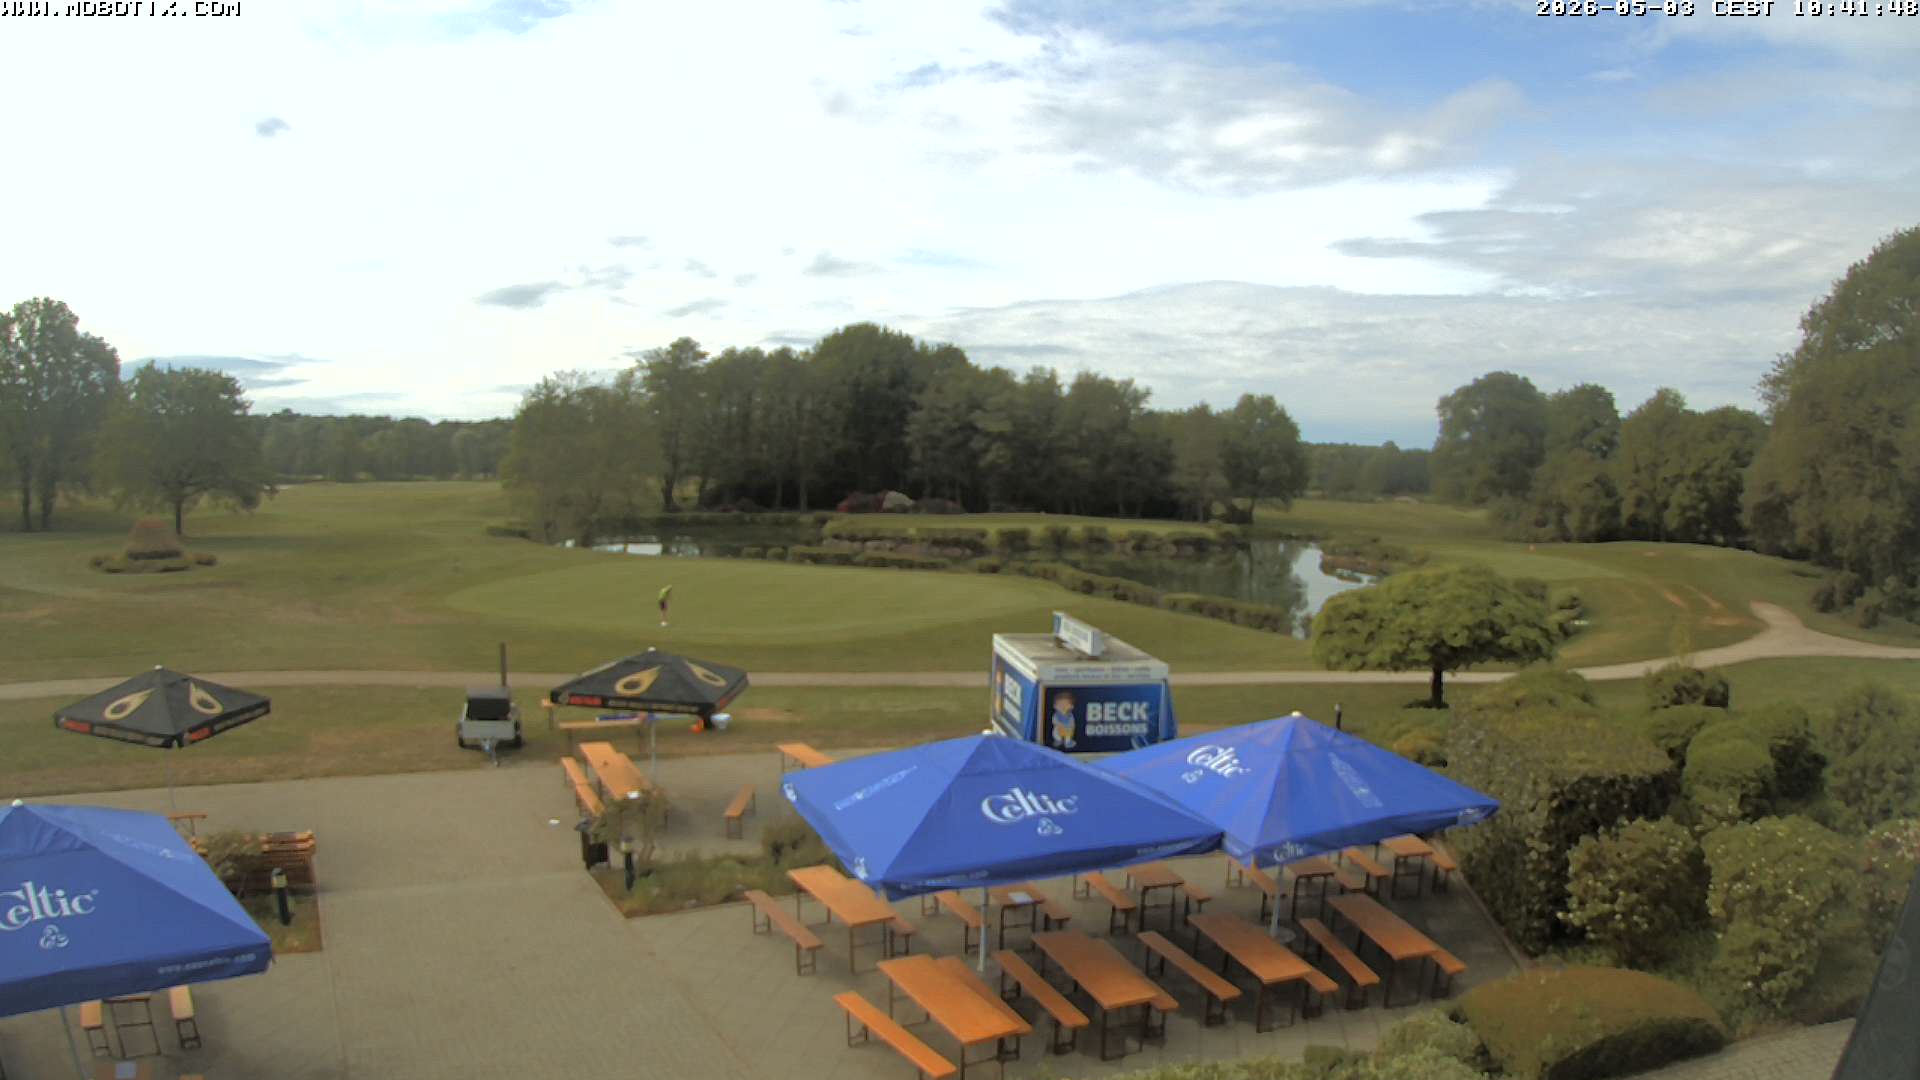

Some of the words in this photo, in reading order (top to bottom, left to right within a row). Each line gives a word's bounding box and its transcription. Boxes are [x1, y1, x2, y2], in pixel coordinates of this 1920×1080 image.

[1087, 702, 1149, 721] BECK
[1085, 723, 1148, 736] BOISSONS
[1187, 745, 1247, 778] Celtic
[981, 786, 1078, 823] Celtic
